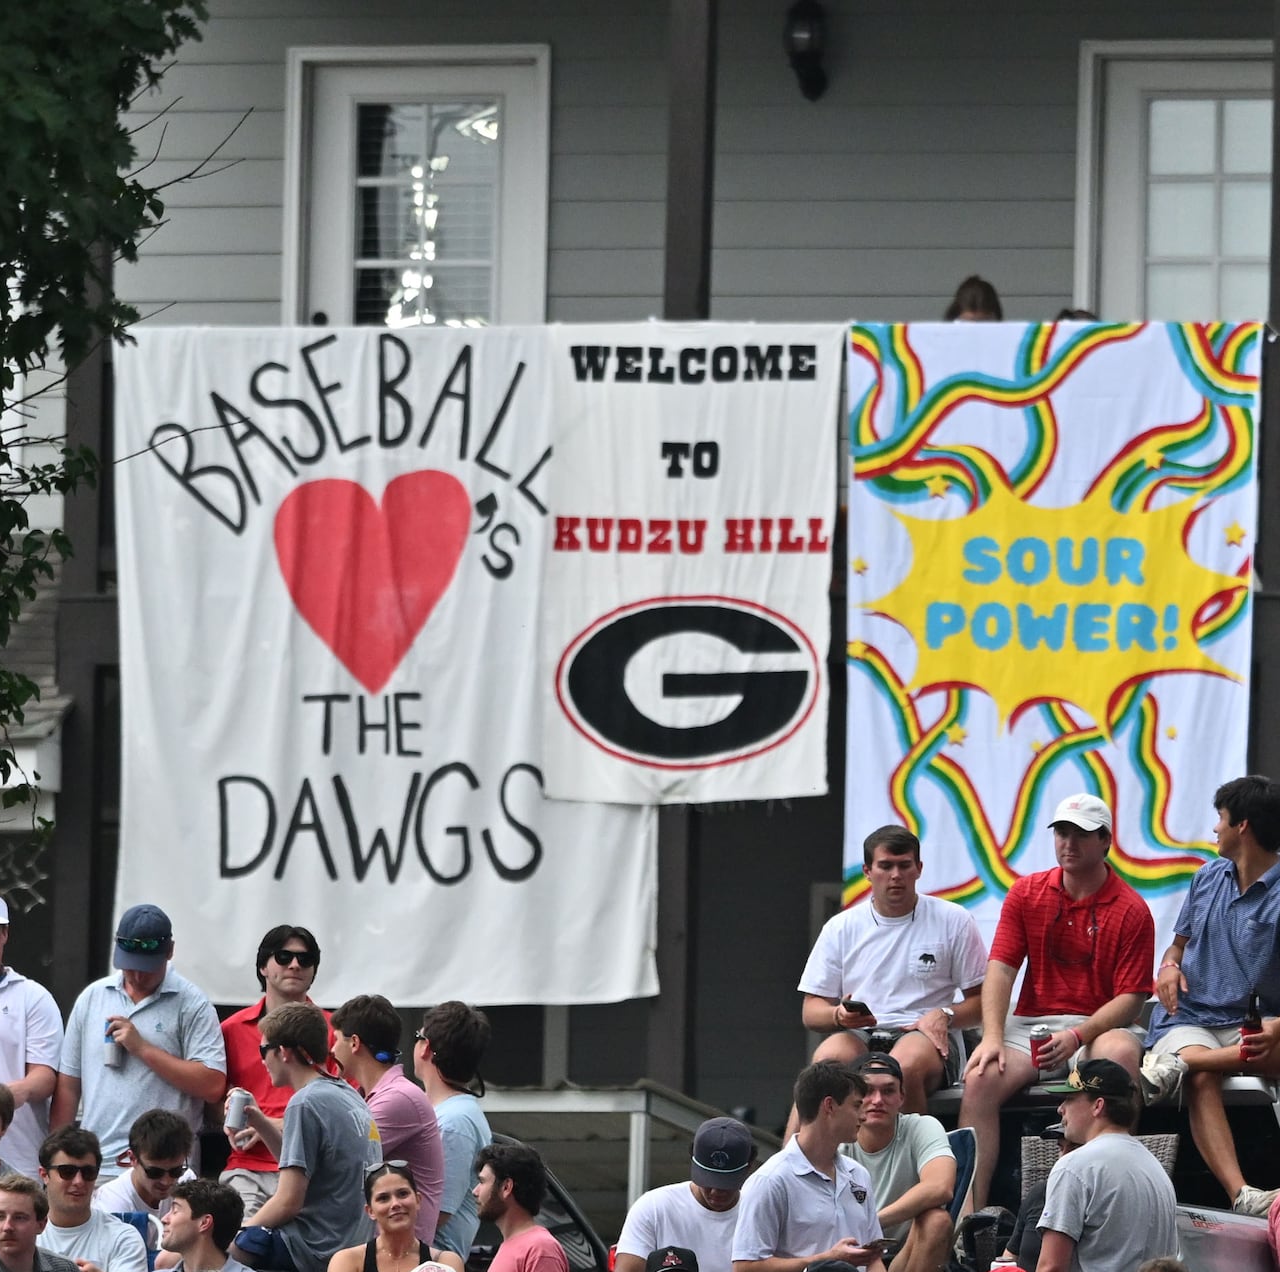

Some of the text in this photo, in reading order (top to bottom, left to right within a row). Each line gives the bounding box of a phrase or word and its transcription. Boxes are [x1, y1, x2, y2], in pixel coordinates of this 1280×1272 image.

[570, 344, 816, 383] WELCOME
[149, 334, 553, 535] BASEBALL
[661, 441, 720, 479] TO
[554, 517, 829, 553] KUDZU HILL
[962, 537, 1145, 585] SOUR
[925, 603, 1180, 651] POWER!
[568, 605, 810, 760] G
[303, 692, 422, 756] THE
[218, 761, 545, 886] DAWGS
